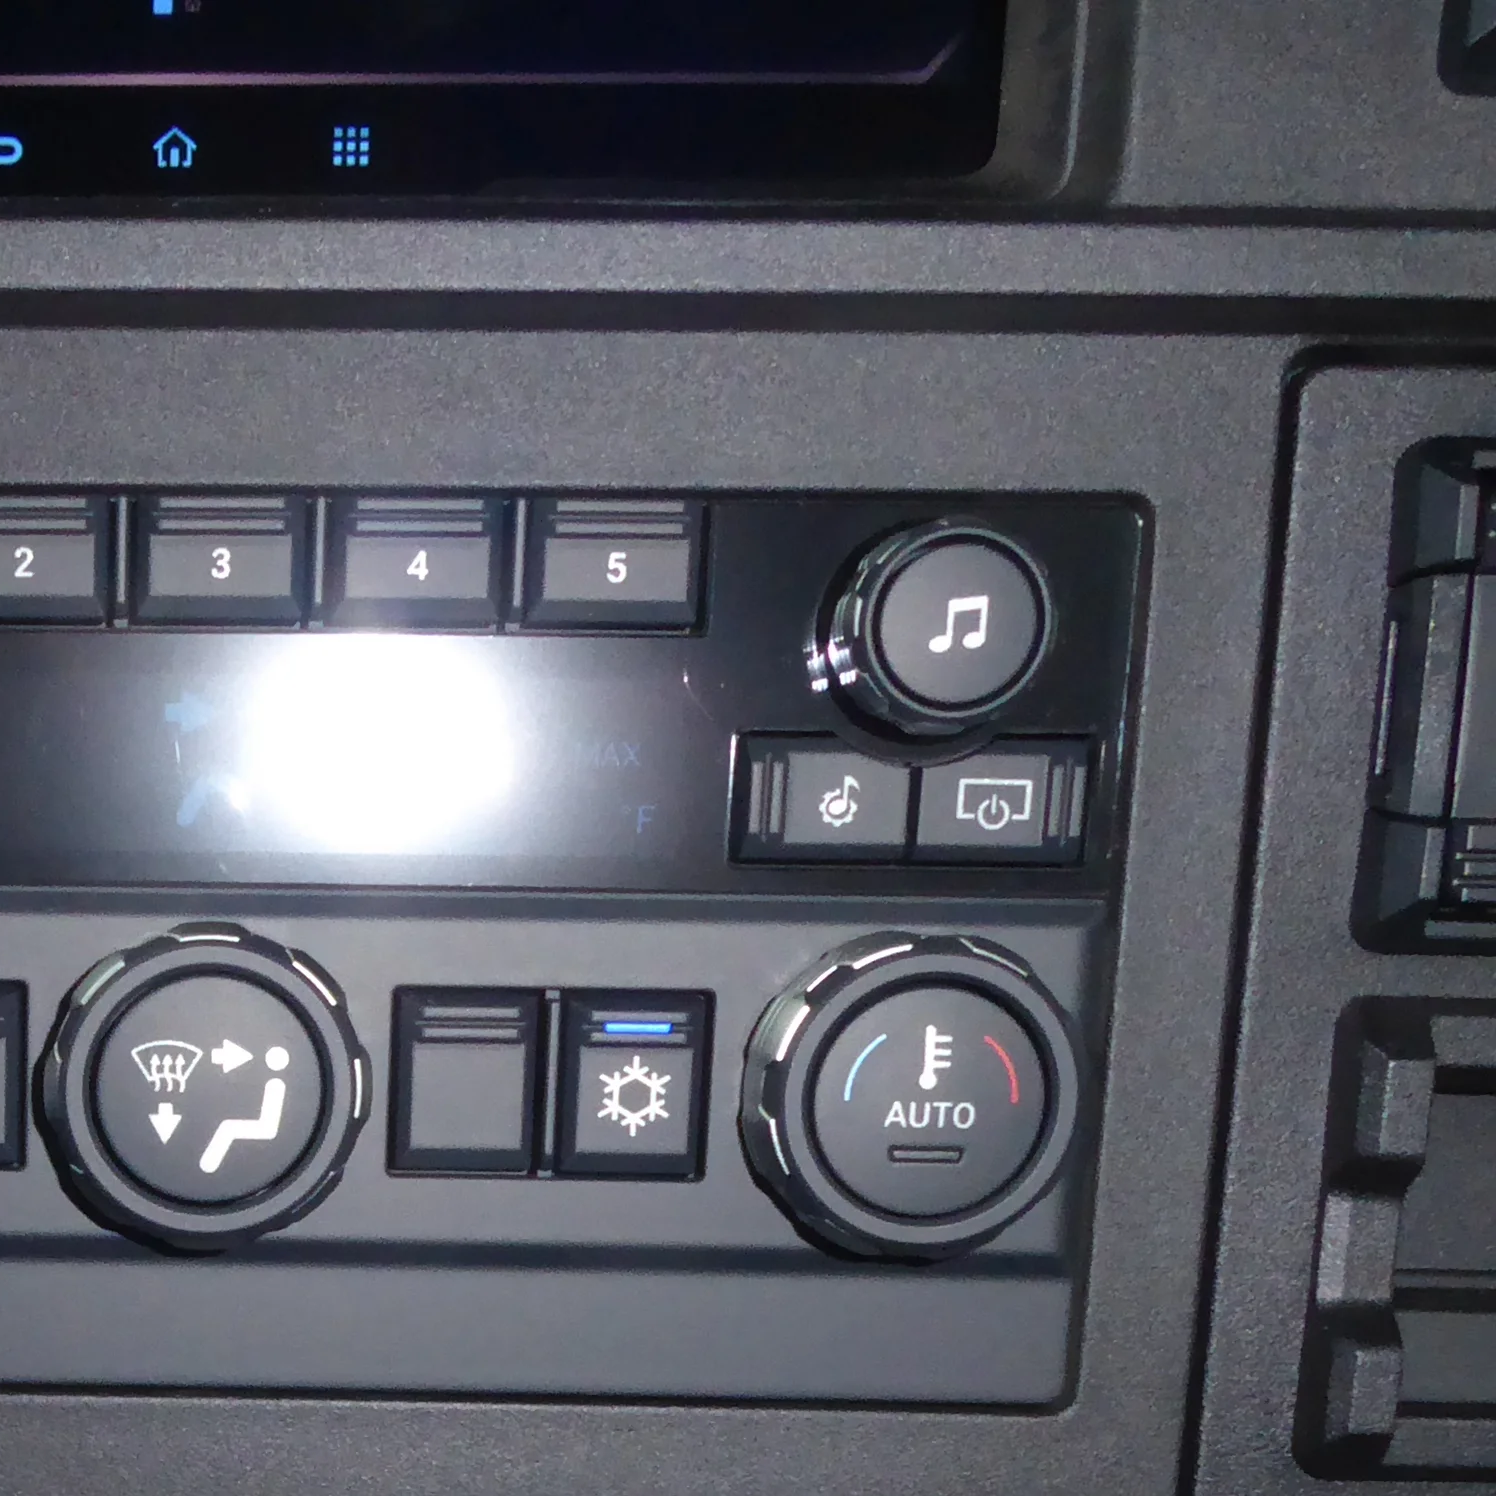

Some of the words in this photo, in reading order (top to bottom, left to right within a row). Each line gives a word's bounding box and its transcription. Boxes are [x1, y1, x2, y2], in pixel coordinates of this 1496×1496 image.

[14, 546, 35, 578] 2
[211, 547, 232, 580] 3
[406, 549, 429, 582] 4
[606, 551, 628, 584] 5
[883, 1100, 976, 1130] AUTO
